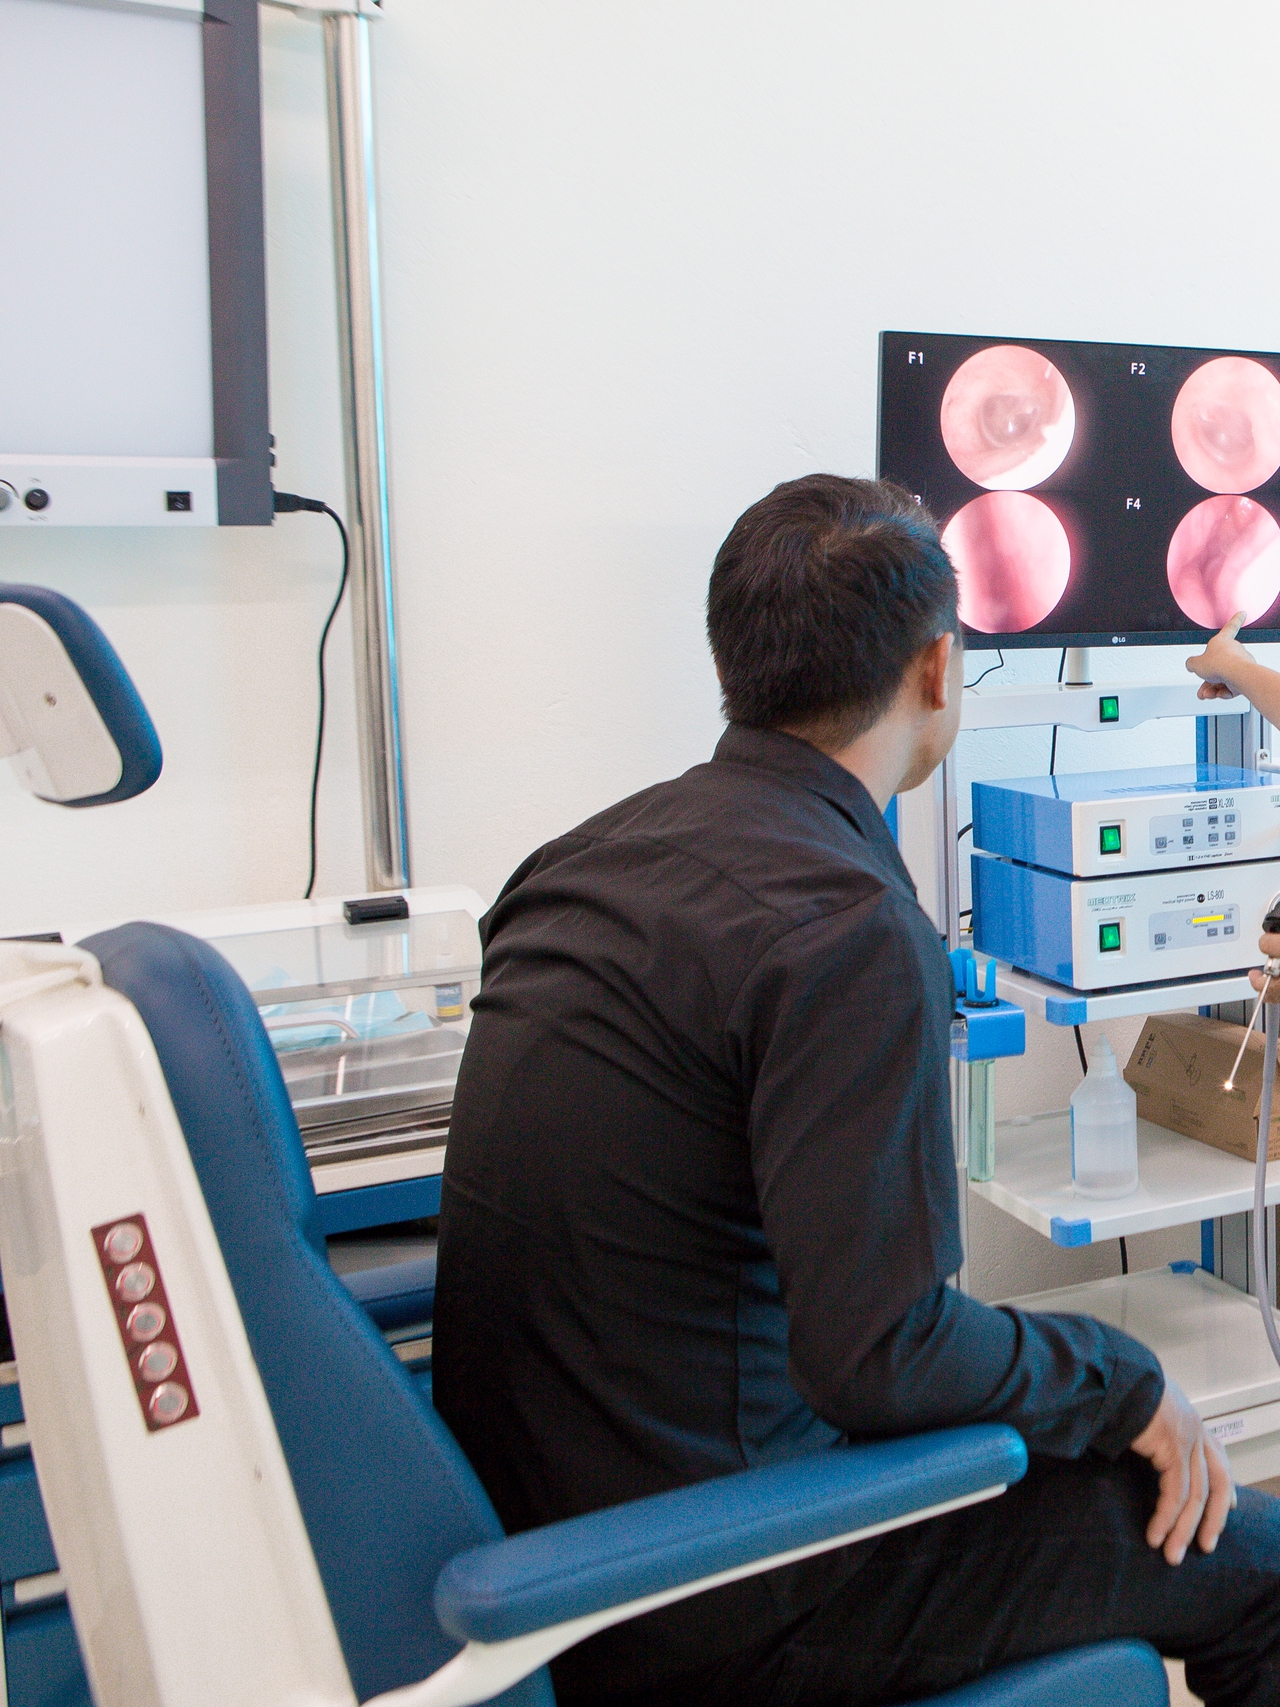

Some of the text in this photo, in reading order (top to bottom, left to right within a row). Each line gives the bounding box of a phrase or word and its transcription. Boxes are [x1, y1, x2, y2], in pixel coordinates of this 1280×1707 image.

[908, 351, 924, 365] F1
[1131, 362, 1146, 375] F2
[1126, 498, 1141, 510] F4
[1207, 890, 1225, 901] LS-800
